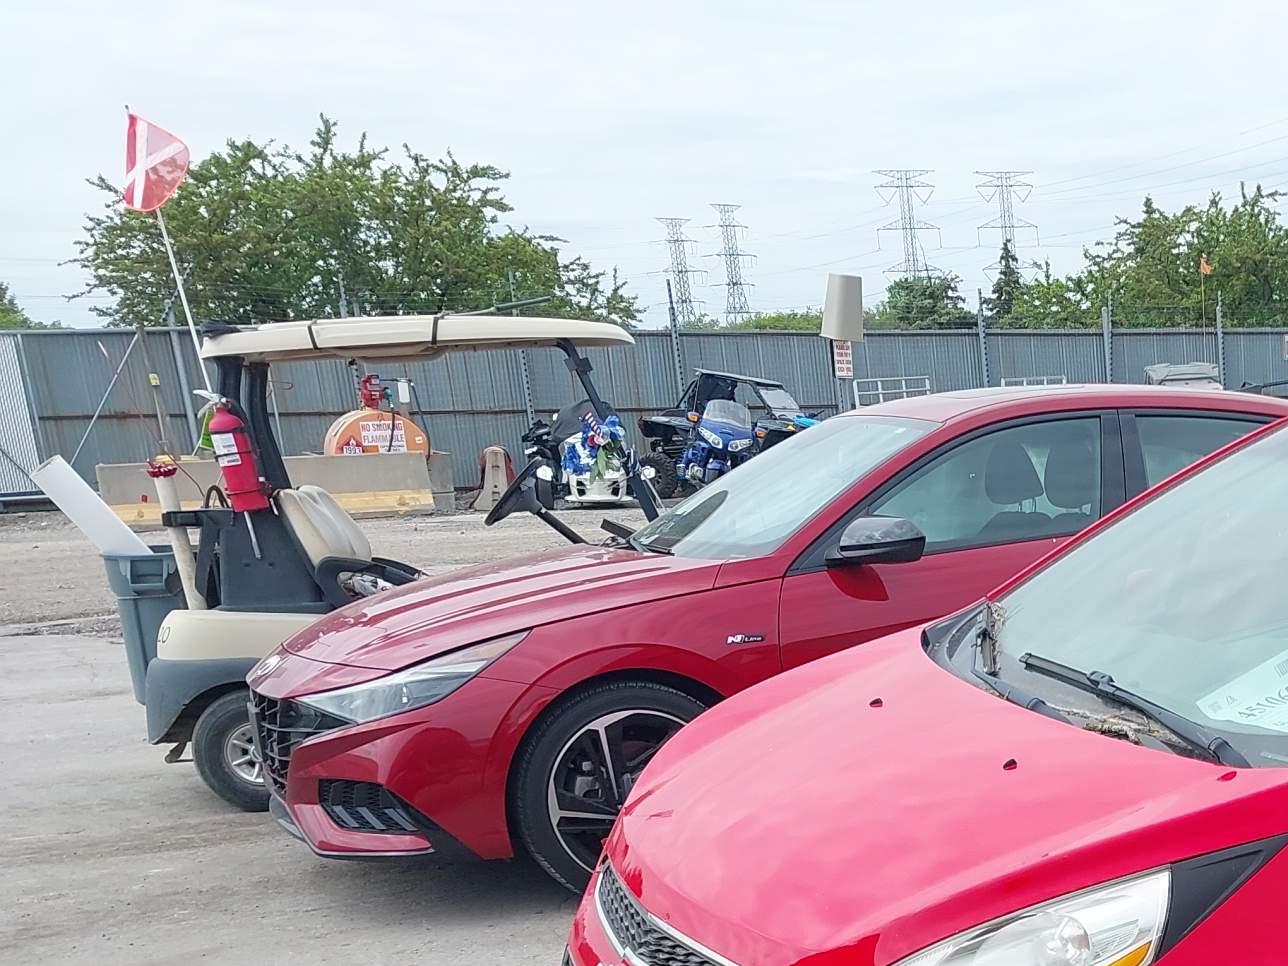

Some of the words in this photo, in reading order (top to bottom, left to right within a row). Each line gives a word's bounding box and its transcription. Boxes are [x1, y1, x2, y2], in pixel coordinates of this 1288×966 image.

[361, 423, 371, 433] NO
[372, 422, 403, 432] SMOKNG
[363, 433, 405, 444] FLAMMBLE
